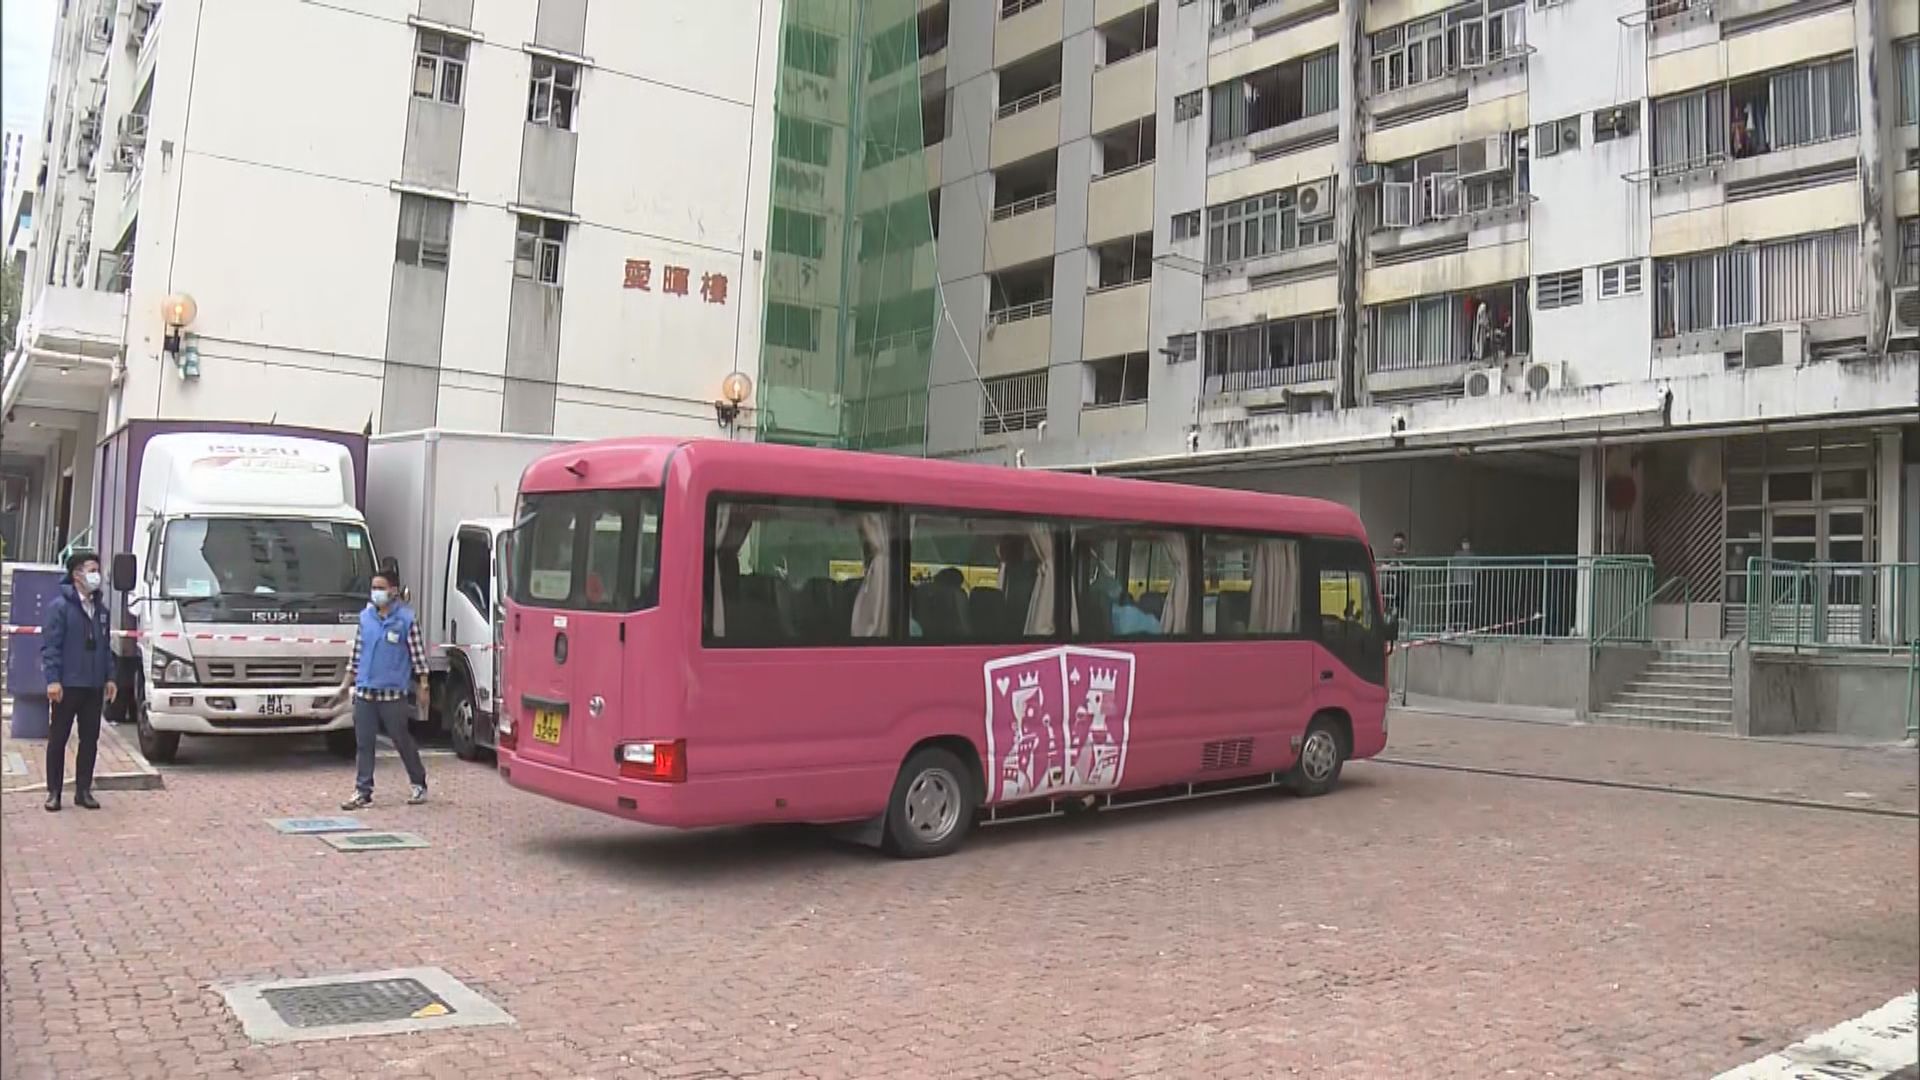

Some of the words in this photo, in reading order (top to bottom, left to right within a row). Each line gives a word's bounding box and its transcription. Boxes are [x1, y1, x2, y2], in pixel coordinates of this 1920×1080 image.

[623, 259, 728, 305] 愛暉樓
[208, 444, 300, 457] ISUZU
[251, 611, 300, 622] ISUZU
[258, 703, 293, 716] 4943
